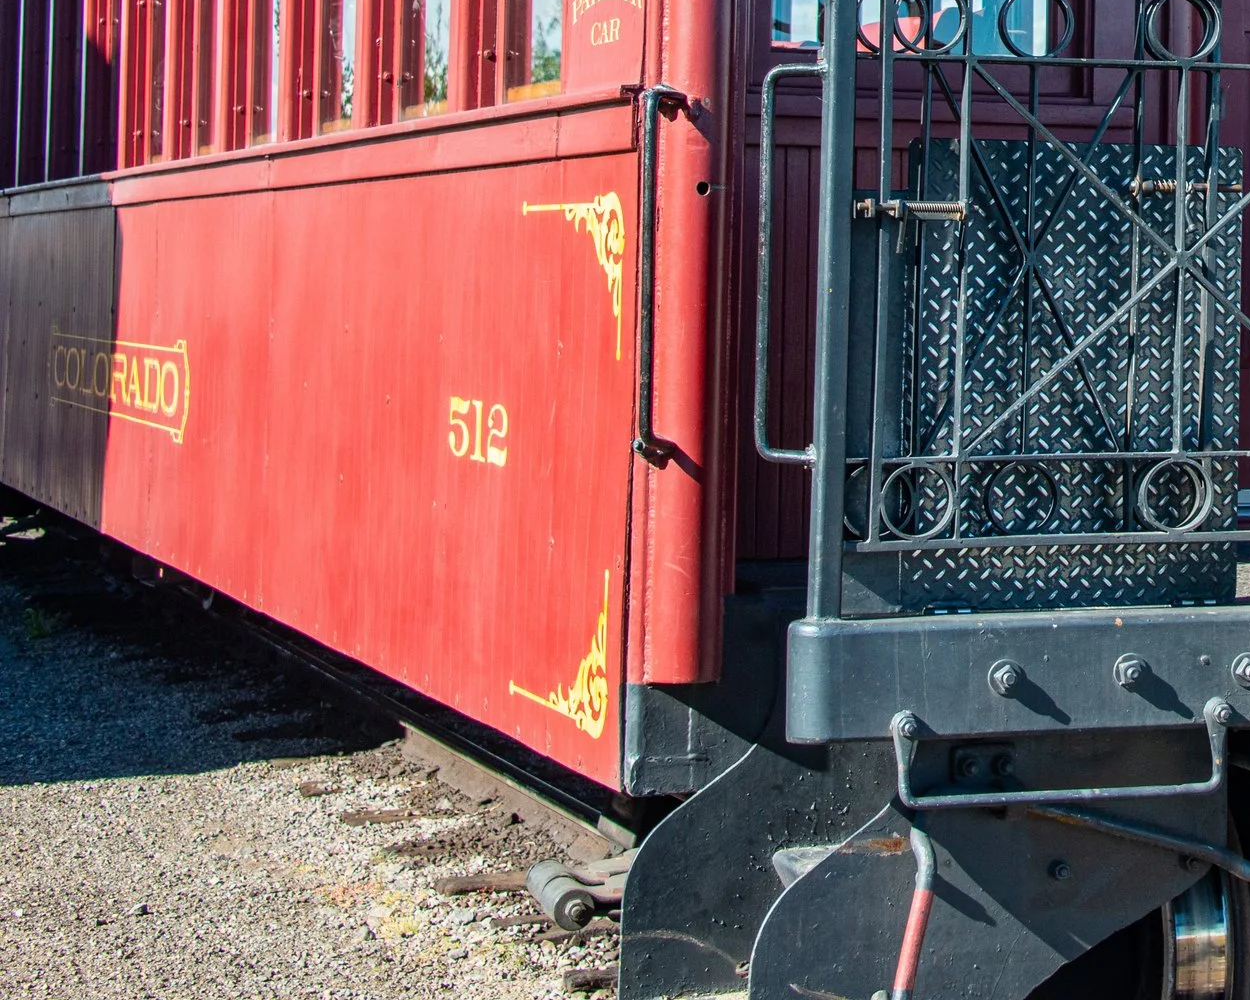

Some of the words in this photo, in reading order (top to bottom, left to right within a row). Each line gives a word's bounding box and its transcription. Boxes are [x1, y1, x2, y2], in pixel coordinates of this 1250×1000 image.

[590, 18, 621, 47] CAR
[54, 345, 179, 417] COLORADO
[448, 396, 508, 467] 512
